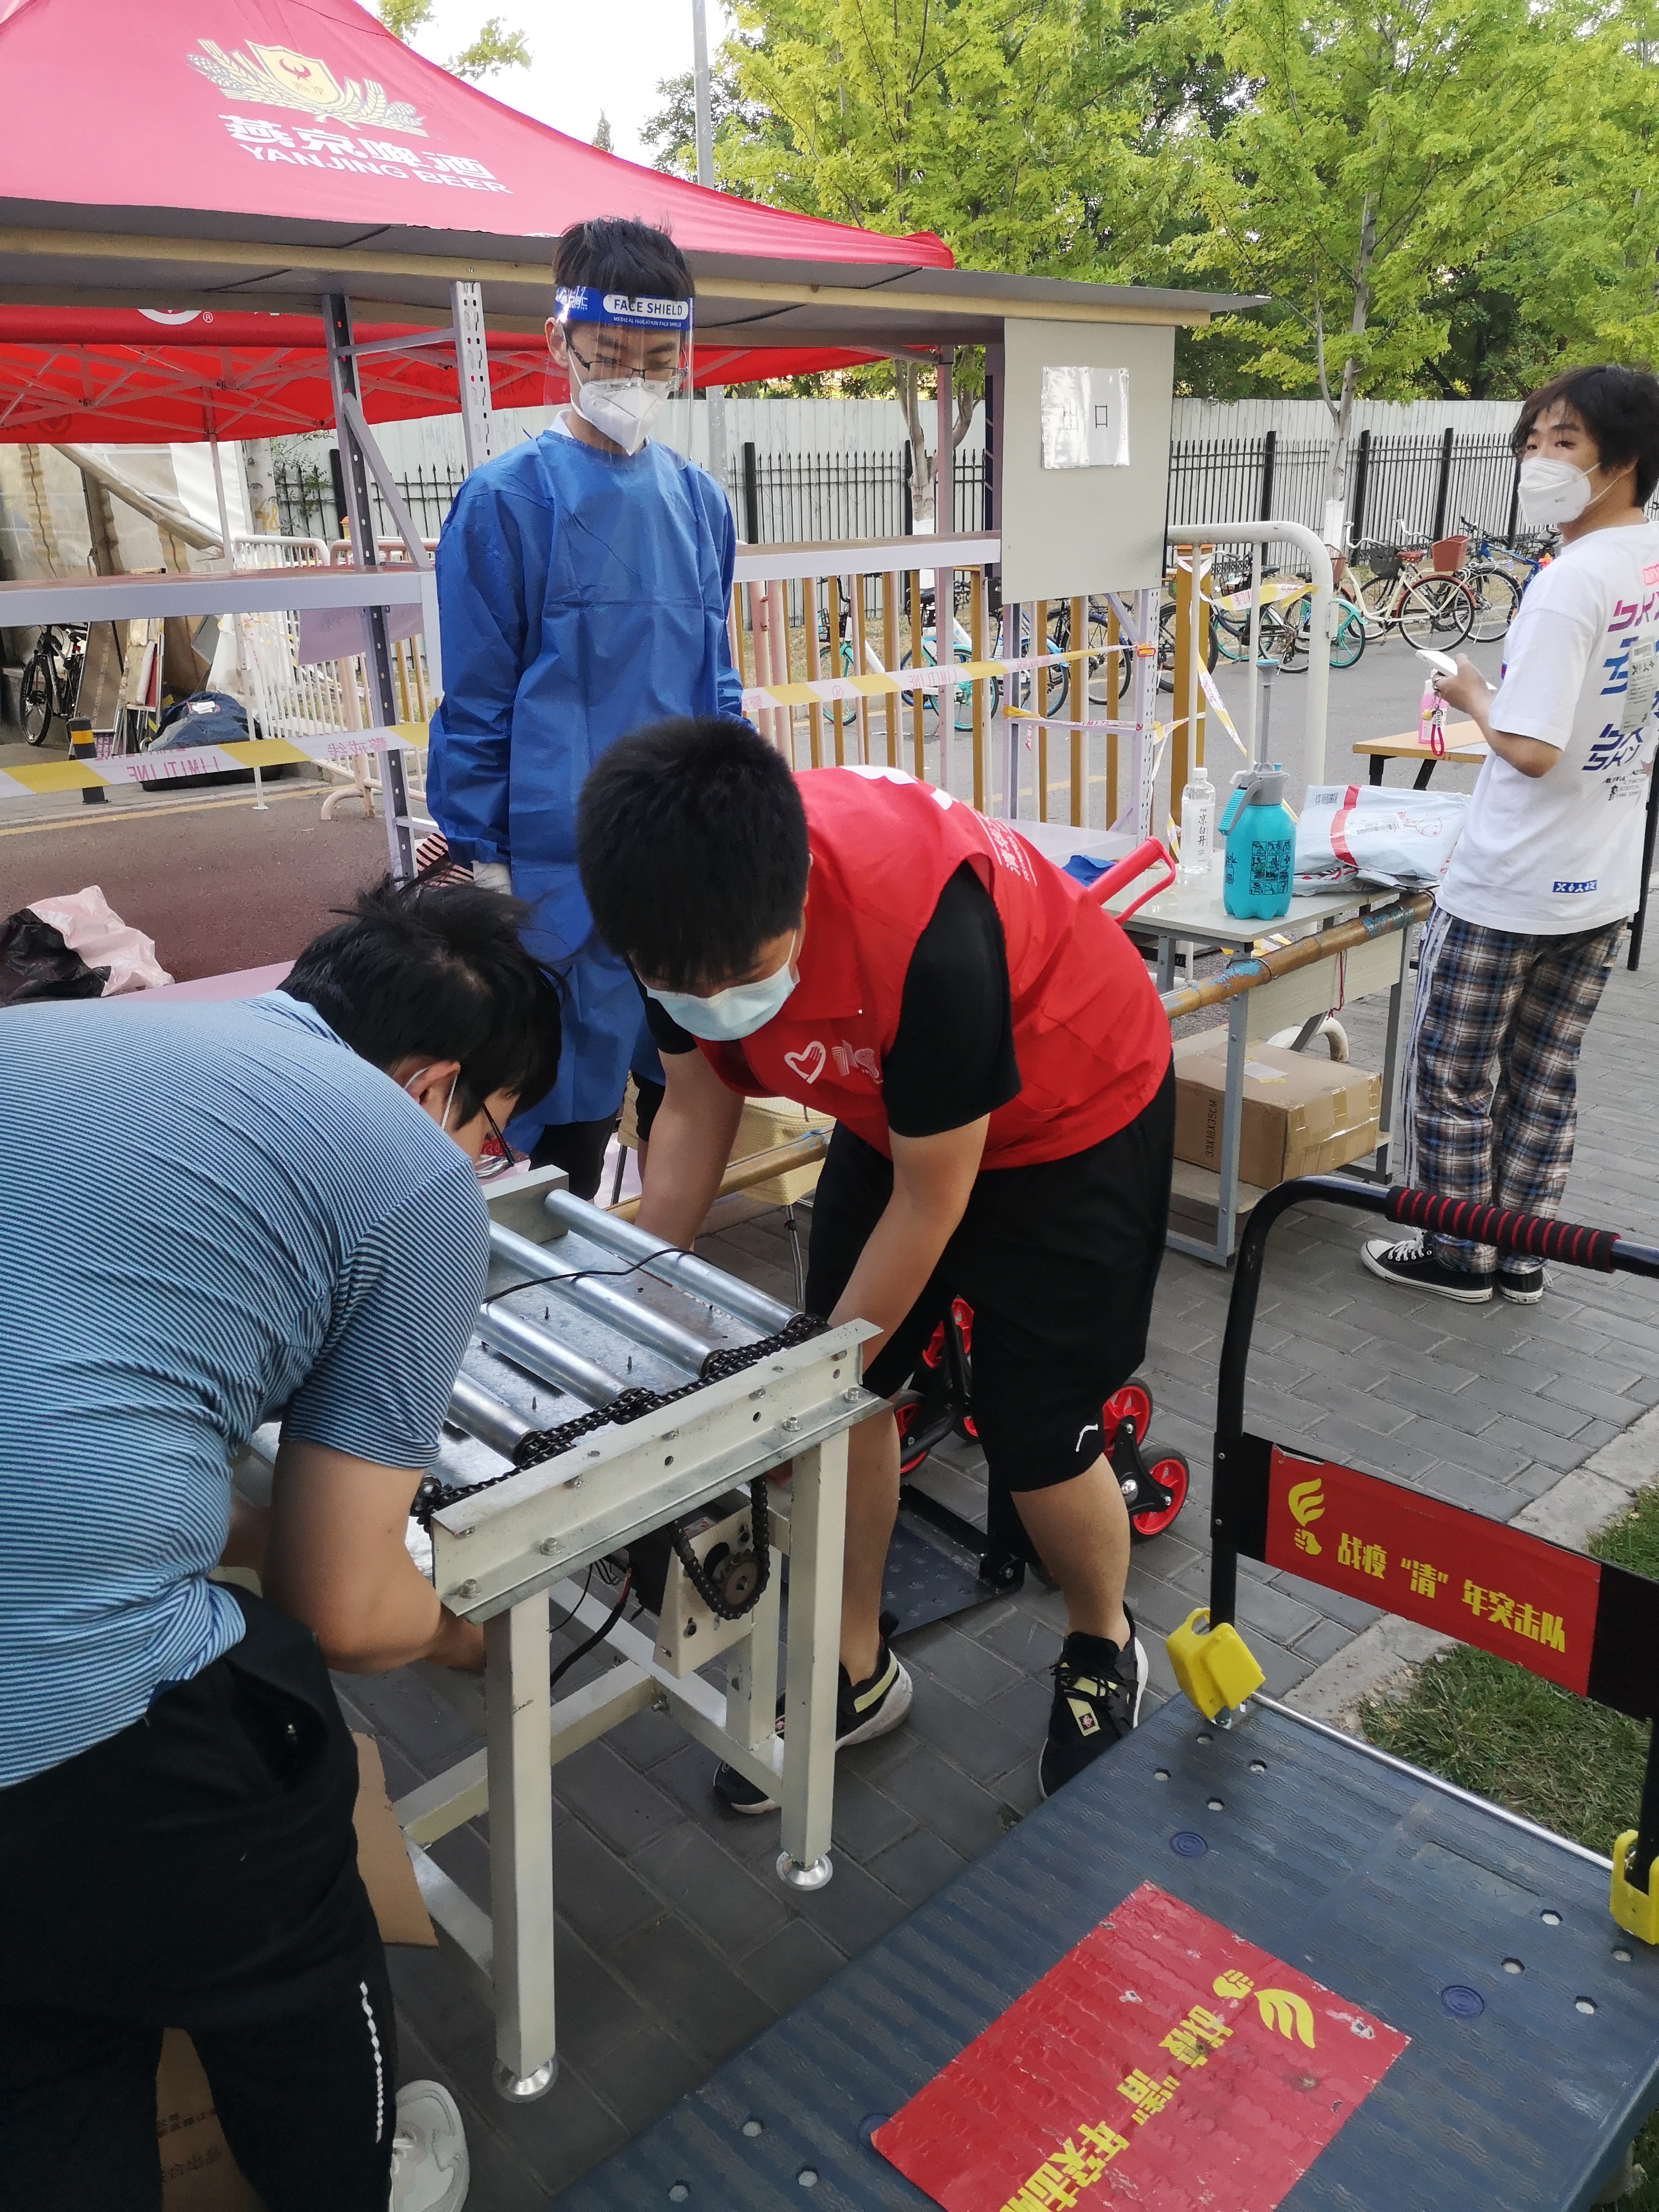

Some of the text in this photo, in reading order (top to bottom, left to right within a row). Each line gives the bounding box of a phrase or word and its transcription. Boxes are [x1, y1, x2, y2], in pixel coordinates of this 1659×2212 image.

[219, 114, 497, 180] 燕京啤酒
[239, 144, 515, 194] YANJING BEER
[614, 298, 683, 316] FACE SHIELD
